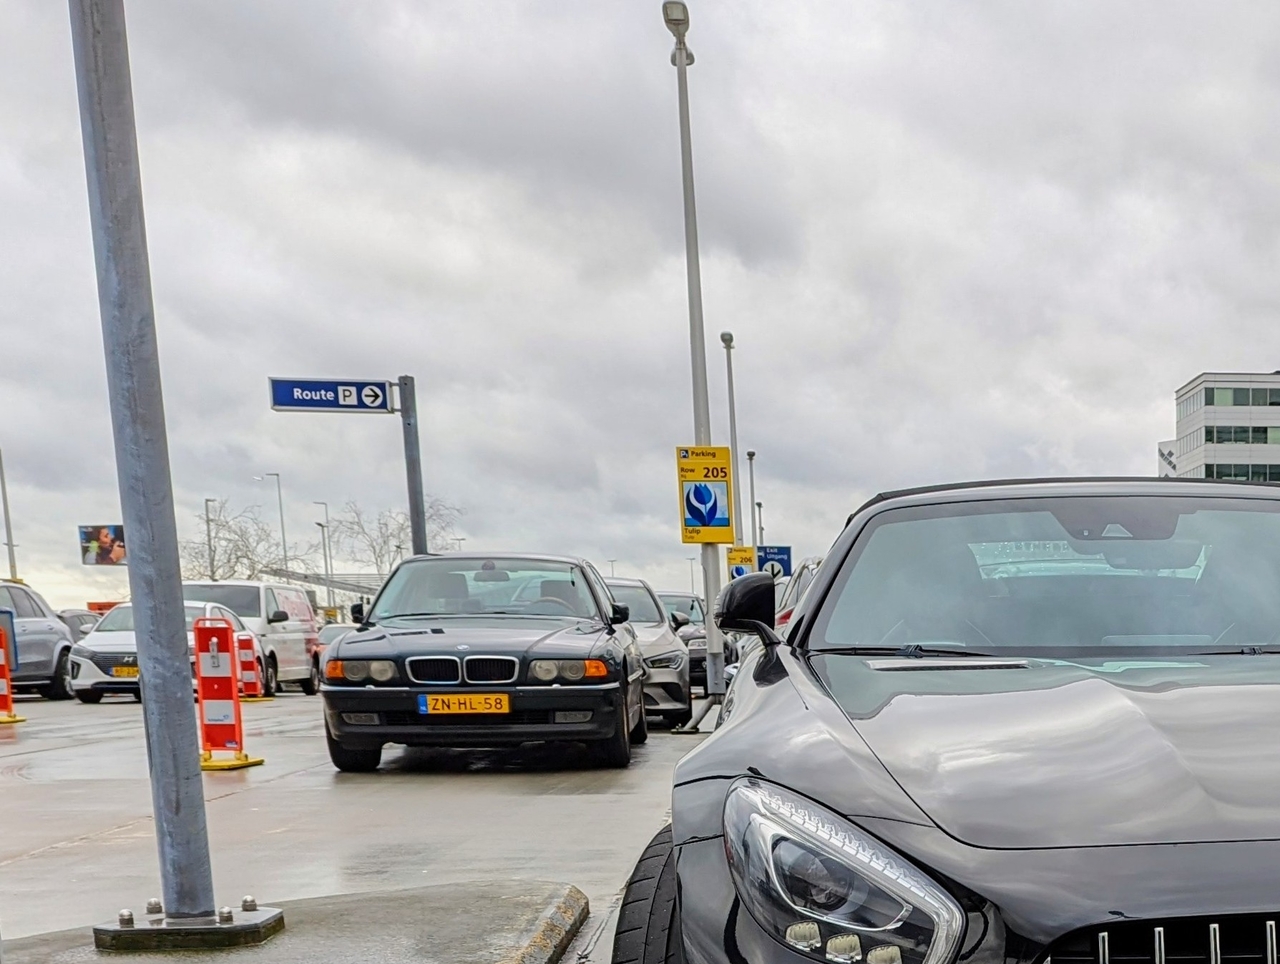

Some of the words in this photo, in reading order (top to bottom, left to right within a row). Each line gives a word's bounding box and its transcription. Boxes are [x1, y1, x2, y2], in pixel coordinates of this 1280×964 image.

[293, 387, 334, 401] Route
[343, 389, 352, 402] P
[703, 467, 728, 478] 205
[431, 697, 503, 711] ZN-HL-58
